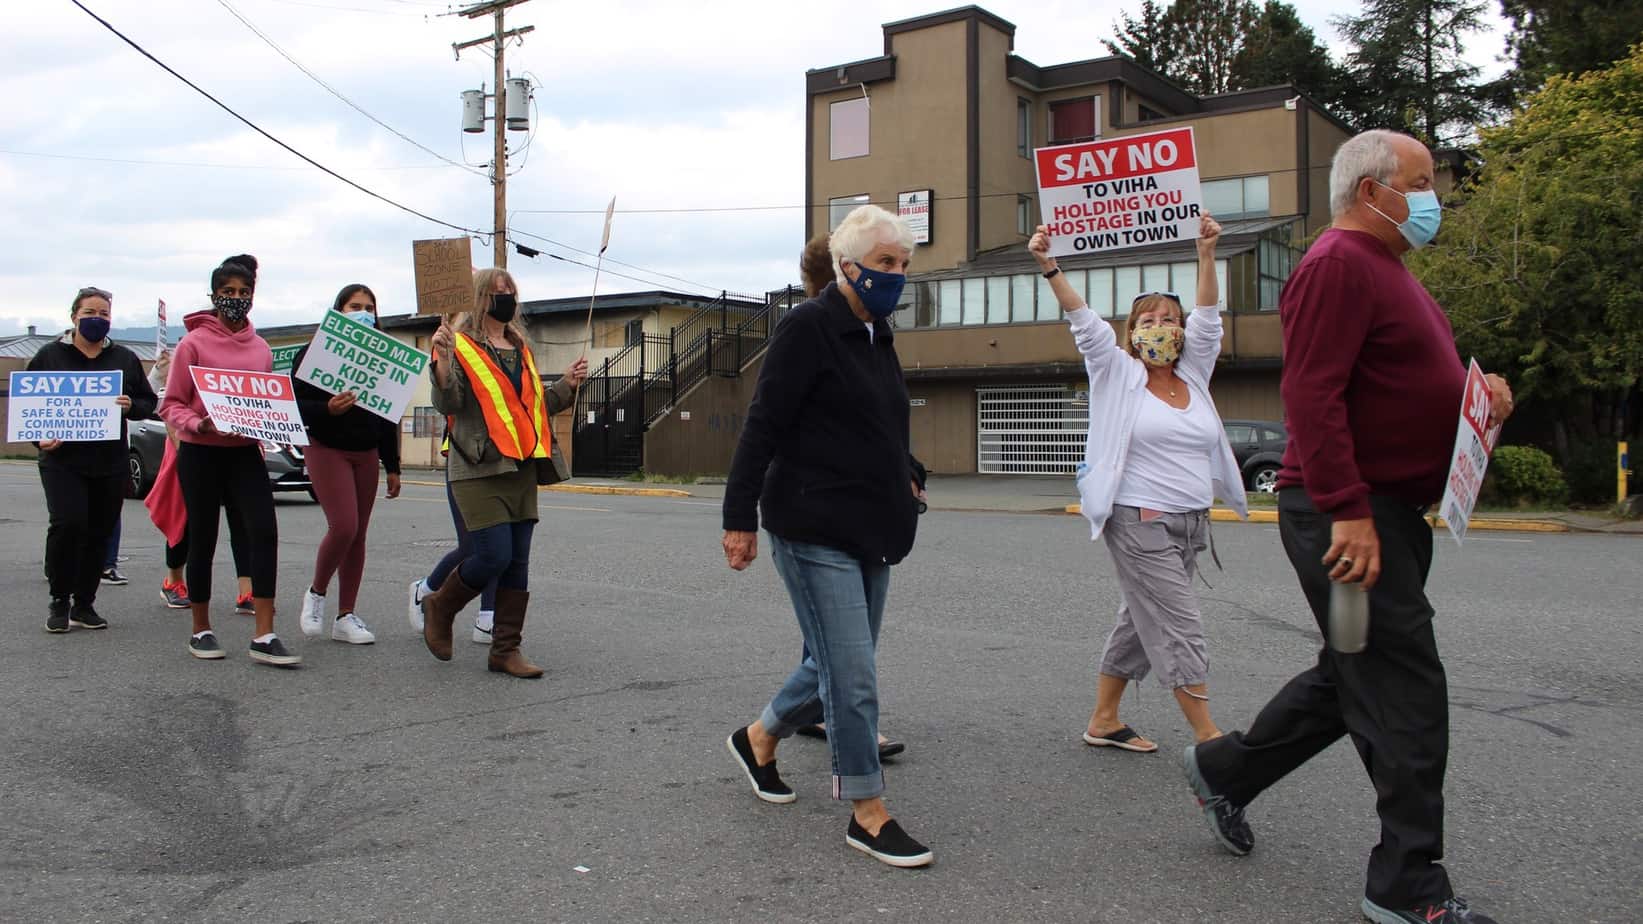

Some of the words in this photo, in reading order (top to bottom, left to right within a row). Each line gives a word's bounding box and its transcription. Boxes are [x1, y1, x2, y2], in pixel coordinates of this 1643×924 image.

[1054, 147, 1119, 182] SAY
[1127, 139, 1178, 172] NO
[1082, 183, 1108, 199] TO
[1111, 176, 1158, 195] VIHA
[1054, 196, 1140, 221] HOLDING
[1144, 190, 1182, 208] YOU
[1047, 213, 1133, 237] HOSTAGE
[1137, 210, 1157, 226] IN
[1161, 203, 1201, 222] OUR
[1073, 232, 1119, 252] OWN
[1122, 224, 1178, 245] TOWN
[324, 314, 389, 353] ELECTED
[389, 346, 422, 371] MLA
[323, 336, 389, 375] TRADES
[388, 367, 409, 386] IN
[20, 376, 65, 394] SAY
[69, 376, 113, 394] YES
[203, 373, 245, 393] SAY
[249, 376, 283, 397] NO
[310, 367, 346, 393] FOR
[338, 363, 378, 389] KIDS
[21, 408, 53, 418] SAFE
[56, 409, 65, 418] &
[68, 408, 108, 417] CLEAN
[46, 398, 71, 407] FOR
[74, 398, 82, 407] A
[211, 403, 265, 420] HOLDING
[264, 411, 289, 421] YOU
[224, 396, 241, 406] TO
[243, 397, 272, 410] VIHA
[25, 419, 104, 429] COMMUNITY
[210, 411, 263, 429] HOSTAGE
[262, 420, 279, 431] IN
[277, 422, 303, 433] OUR
[18, 430, 42, 440] FOR
[46, 430, 73, 440] OUR
[230, 425, 258, 438] OWN
[258, 430, 292, 443] TOWN
